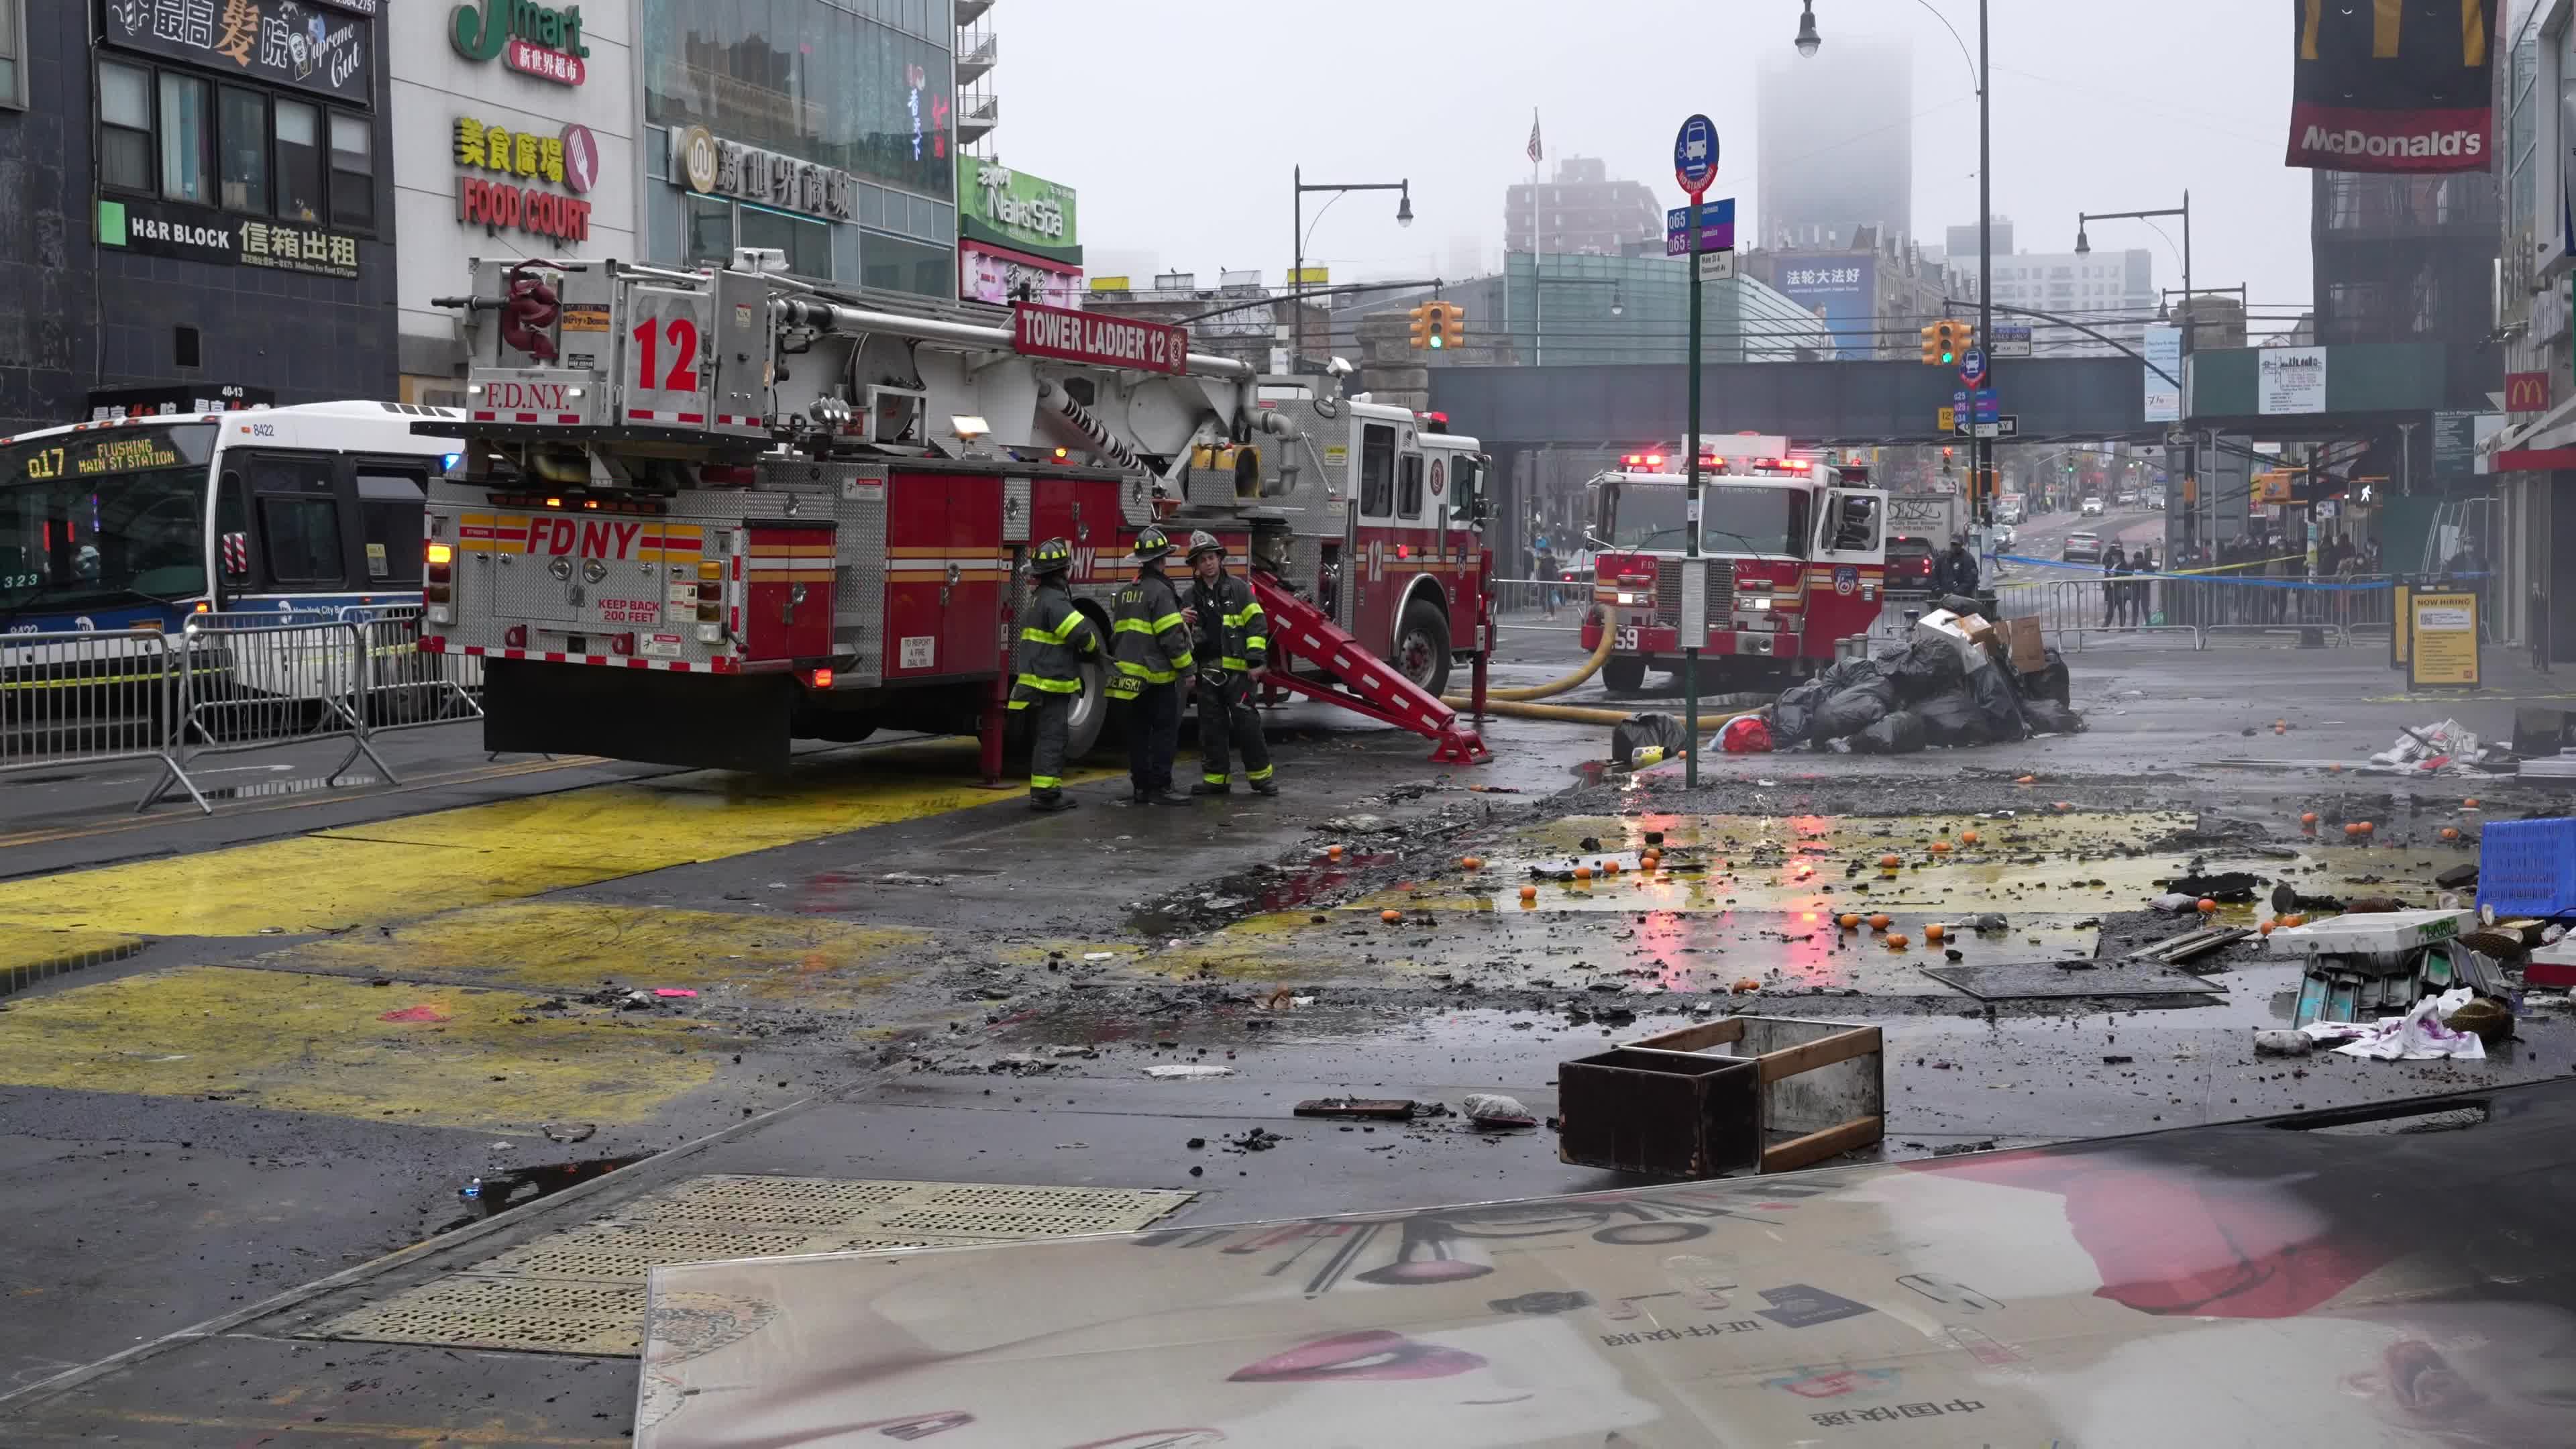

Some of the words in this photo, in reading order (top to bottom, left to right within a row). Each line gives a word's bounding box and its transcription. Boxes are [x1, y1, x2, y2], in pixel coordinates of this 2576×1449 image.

[307, 23, 354, 67] upreme
[331, 44, 361, 88] Cut
[519, 46, 577, 81] 新世界超市
[460, 117, 564, 183] 美食廣場
[2301, 125, 2481, 157] McDonald's
[463, 176, 521, 227] FOOD
[525, 189, 591, 241] COURT
[1031, 200, 1063, 238] Spa
[132, 217, 170, 240] H&R
[174, 223, 230, 249] BLOCK
[238, 221, 358, 266] 信箱出租
[1787, 268, 1860, 284] 法轮大法好
[1023, 310, 1081, 351] TOWER
[1085, 319, 1145, 360] LADDER
[1149, 330, 1165, 363] 12
[633, 316, 698, 392] 12
[222, 386, 243, 398] 40-13
[486, 383, 570, 410] F.D.N.Y.
[254, 424, 274, 436] 8422
[78, 459, 105, 473] MAIN
[110, 456, 122, 470] ST
[128, 451, 175, 468] STATION
[97, 439, 152, 457] FLUSHING
[527, 517, 641, 559] FDNY
[1368, 540, 1384, 582] 12
[321, 606, 333, 616] City
[598, 599, 627, 610] KEEP
[629, 600, 660, 612] BACK
[604, 611, 625, 621] 200
[629, 612, 654, 623] FEET
[2440, 598, 2471, 606] HIRING
[1614, 629, 1638, 649] 59
[1599, 1319, 1763, 1347] 证件快照
[1809, 1398, 1985, 1428] 中国快递
